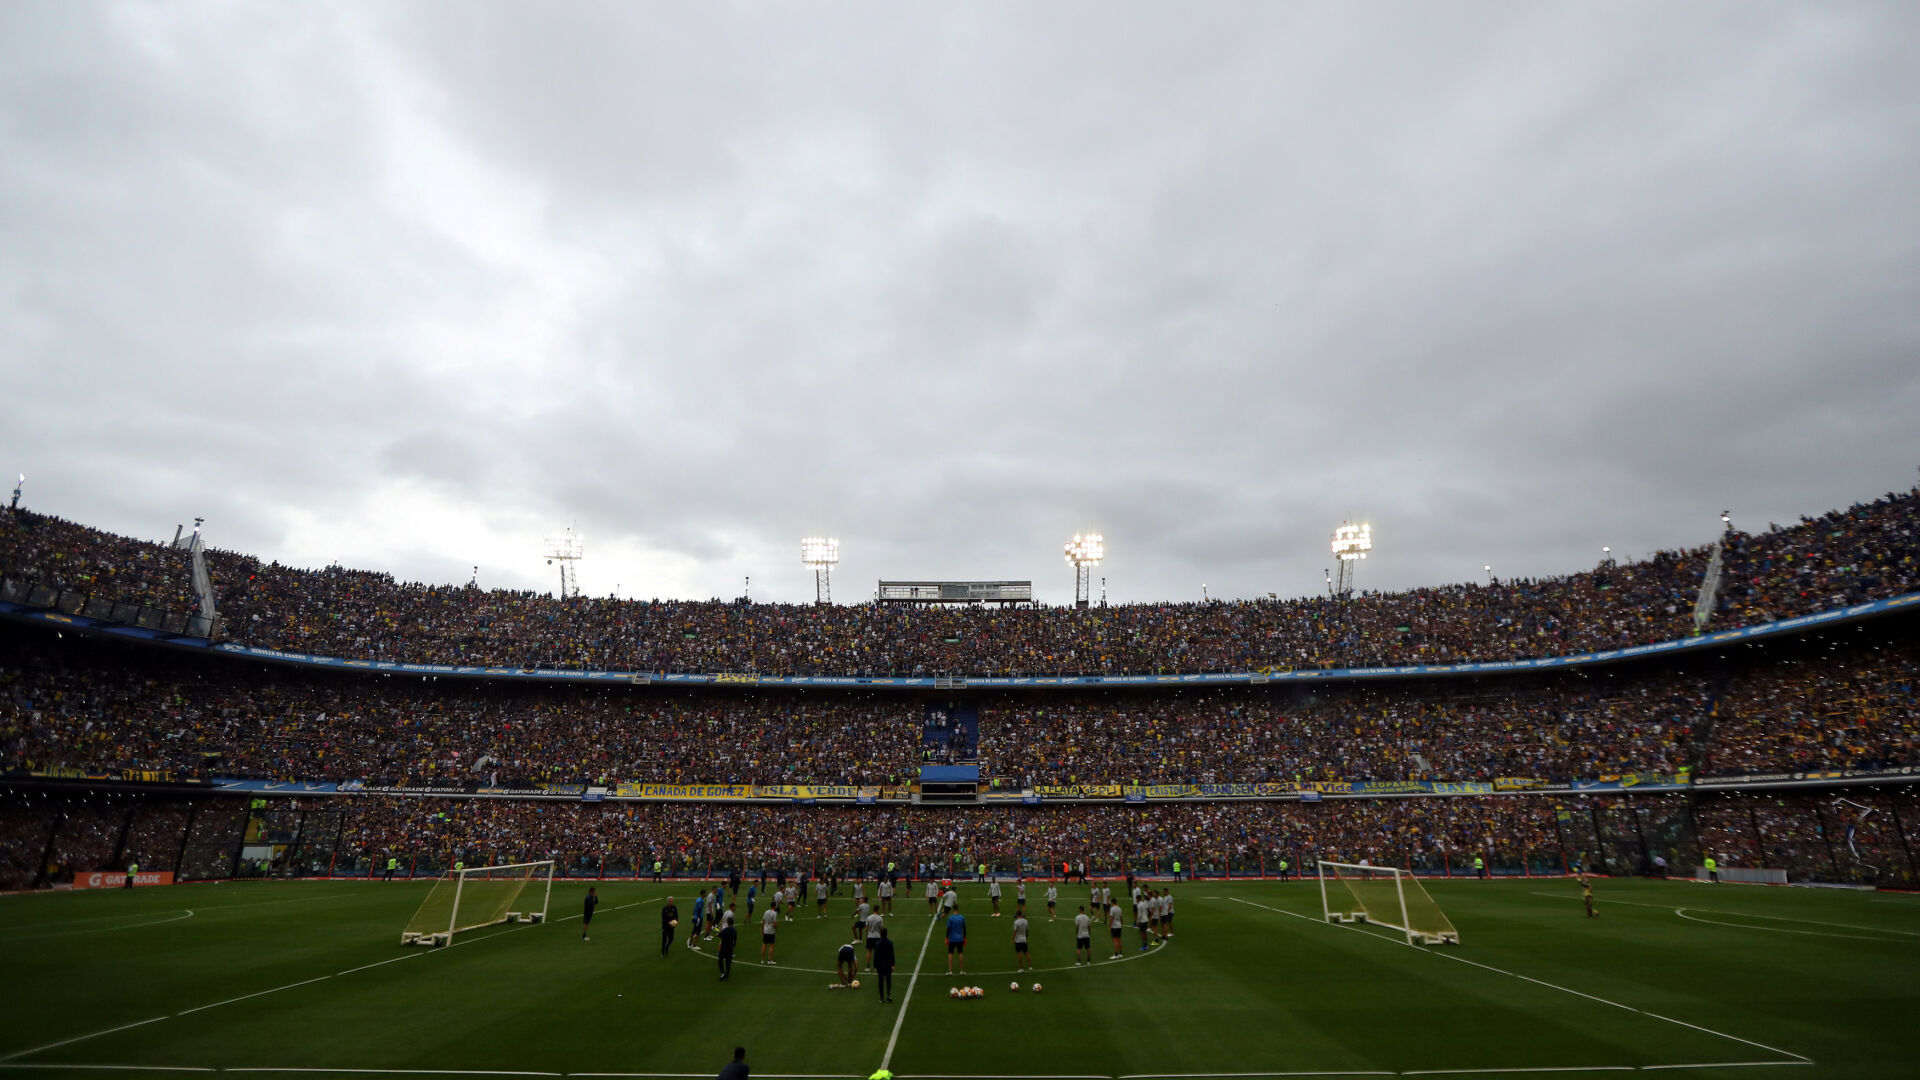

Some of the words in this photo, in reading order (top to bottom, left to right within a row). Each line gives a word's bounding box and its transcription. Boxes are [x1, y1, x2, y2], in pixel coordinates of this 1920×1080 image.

[690, 787, 705, 796] DE
[707, 786, 745, 796] GOMEZ
[764, 786, 798, 796] ISLA
[807, 786, 857, 796] VERDE
[1203, 785, 1255, 796] BRANDSEN
[105, 874, 161, 885] GATRADE
